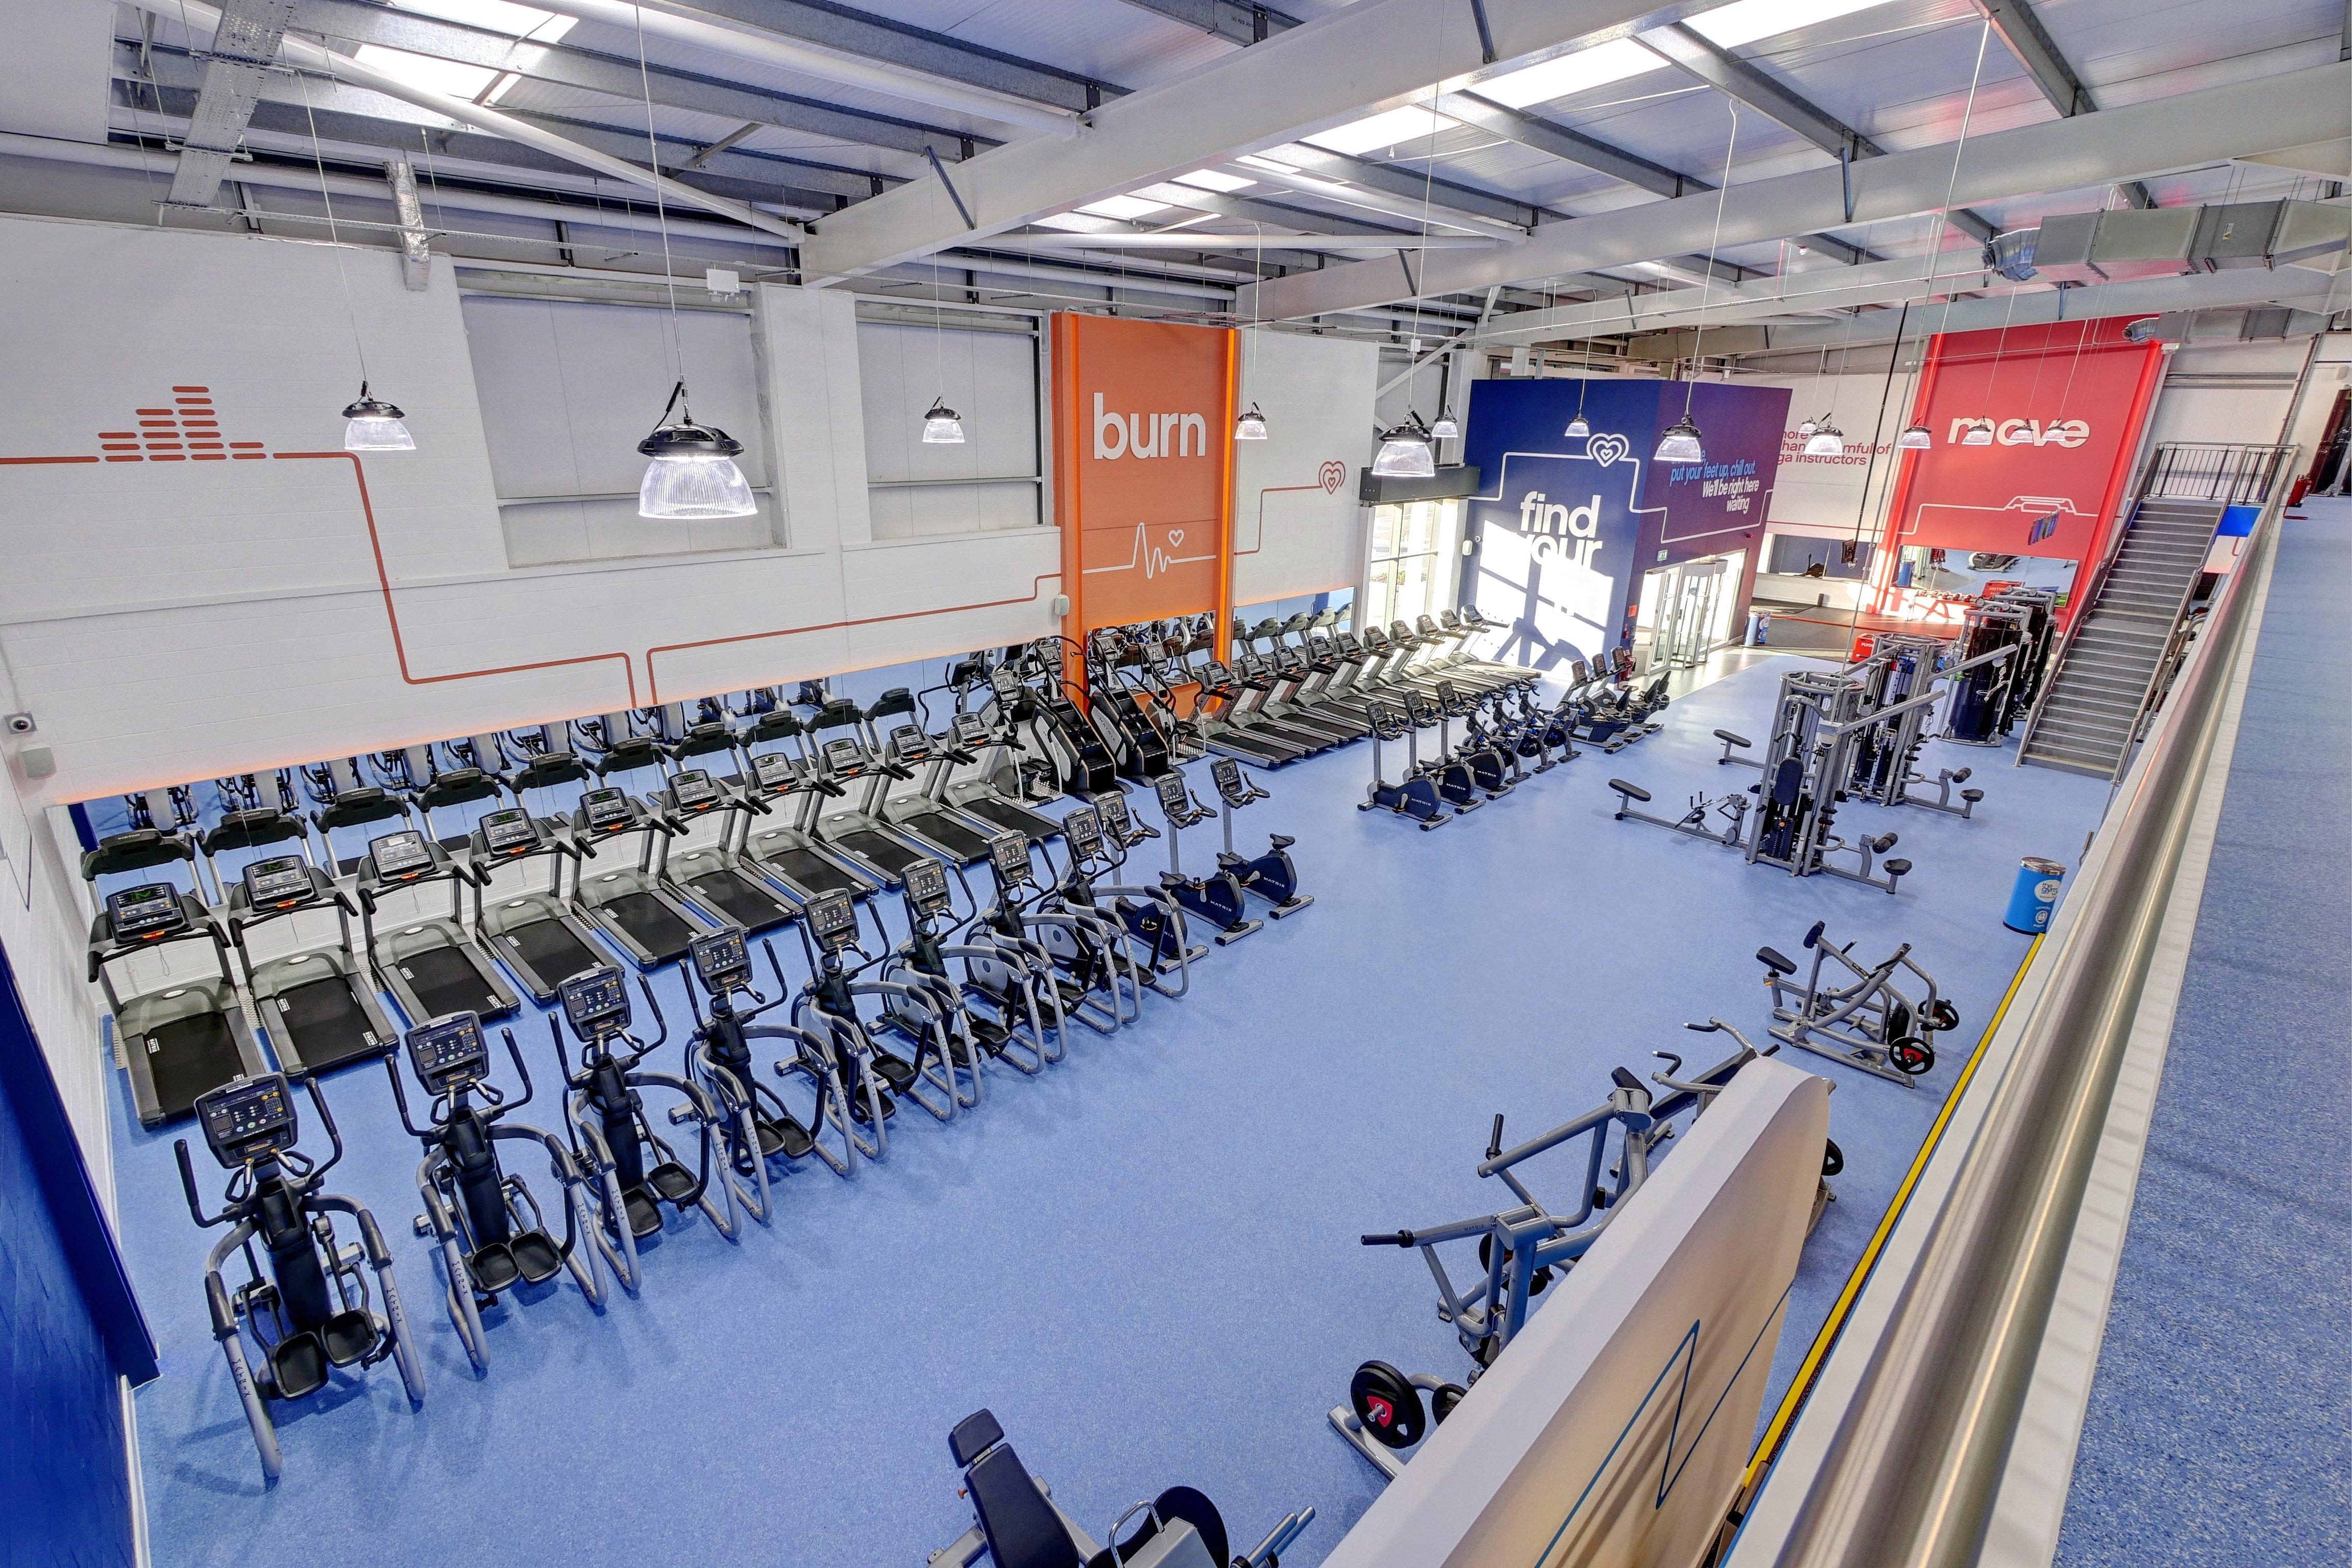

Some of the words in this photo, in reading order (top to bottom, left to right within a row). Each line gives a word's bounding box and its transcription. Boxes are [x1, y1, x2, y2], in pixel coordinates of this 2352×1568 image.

[1093, 392, 1206, 460] burn
[1947, 418, 2090, 449] move
[1796, 452, 1867, 465] instructors
[1876, 443, 1892, 455] of
[1670, 465, 1684, 487] put
[1684, 466, 1703, 486] your
[1703, 462, 1719, 479] feet
[1719, 464, 1729, 479] up,
[1730, 459, 1745, 477] chill
[1719, 479, 1728, 496] be
[1728, 477, 1744, 499] right
[1744, 476, 1759, 493] here
[1520, 491, 1602, 538] find
[1726, 495, 1750, 514] waiting
[1526, 534, 1603, 570] our
[1477, 770, 1497, 778] MATRIX
[1446, 782, 1466, 791] MATRIX
[1411, 797, 1432, 806] MATRIX
[1263, 876, 1285, 888] MATRIX
[1210, 900, 1232, 912] MATRIX
[386, 1287, 402, 1324] MATRIX
[232, 1358, 251, 1398] MATRIX
